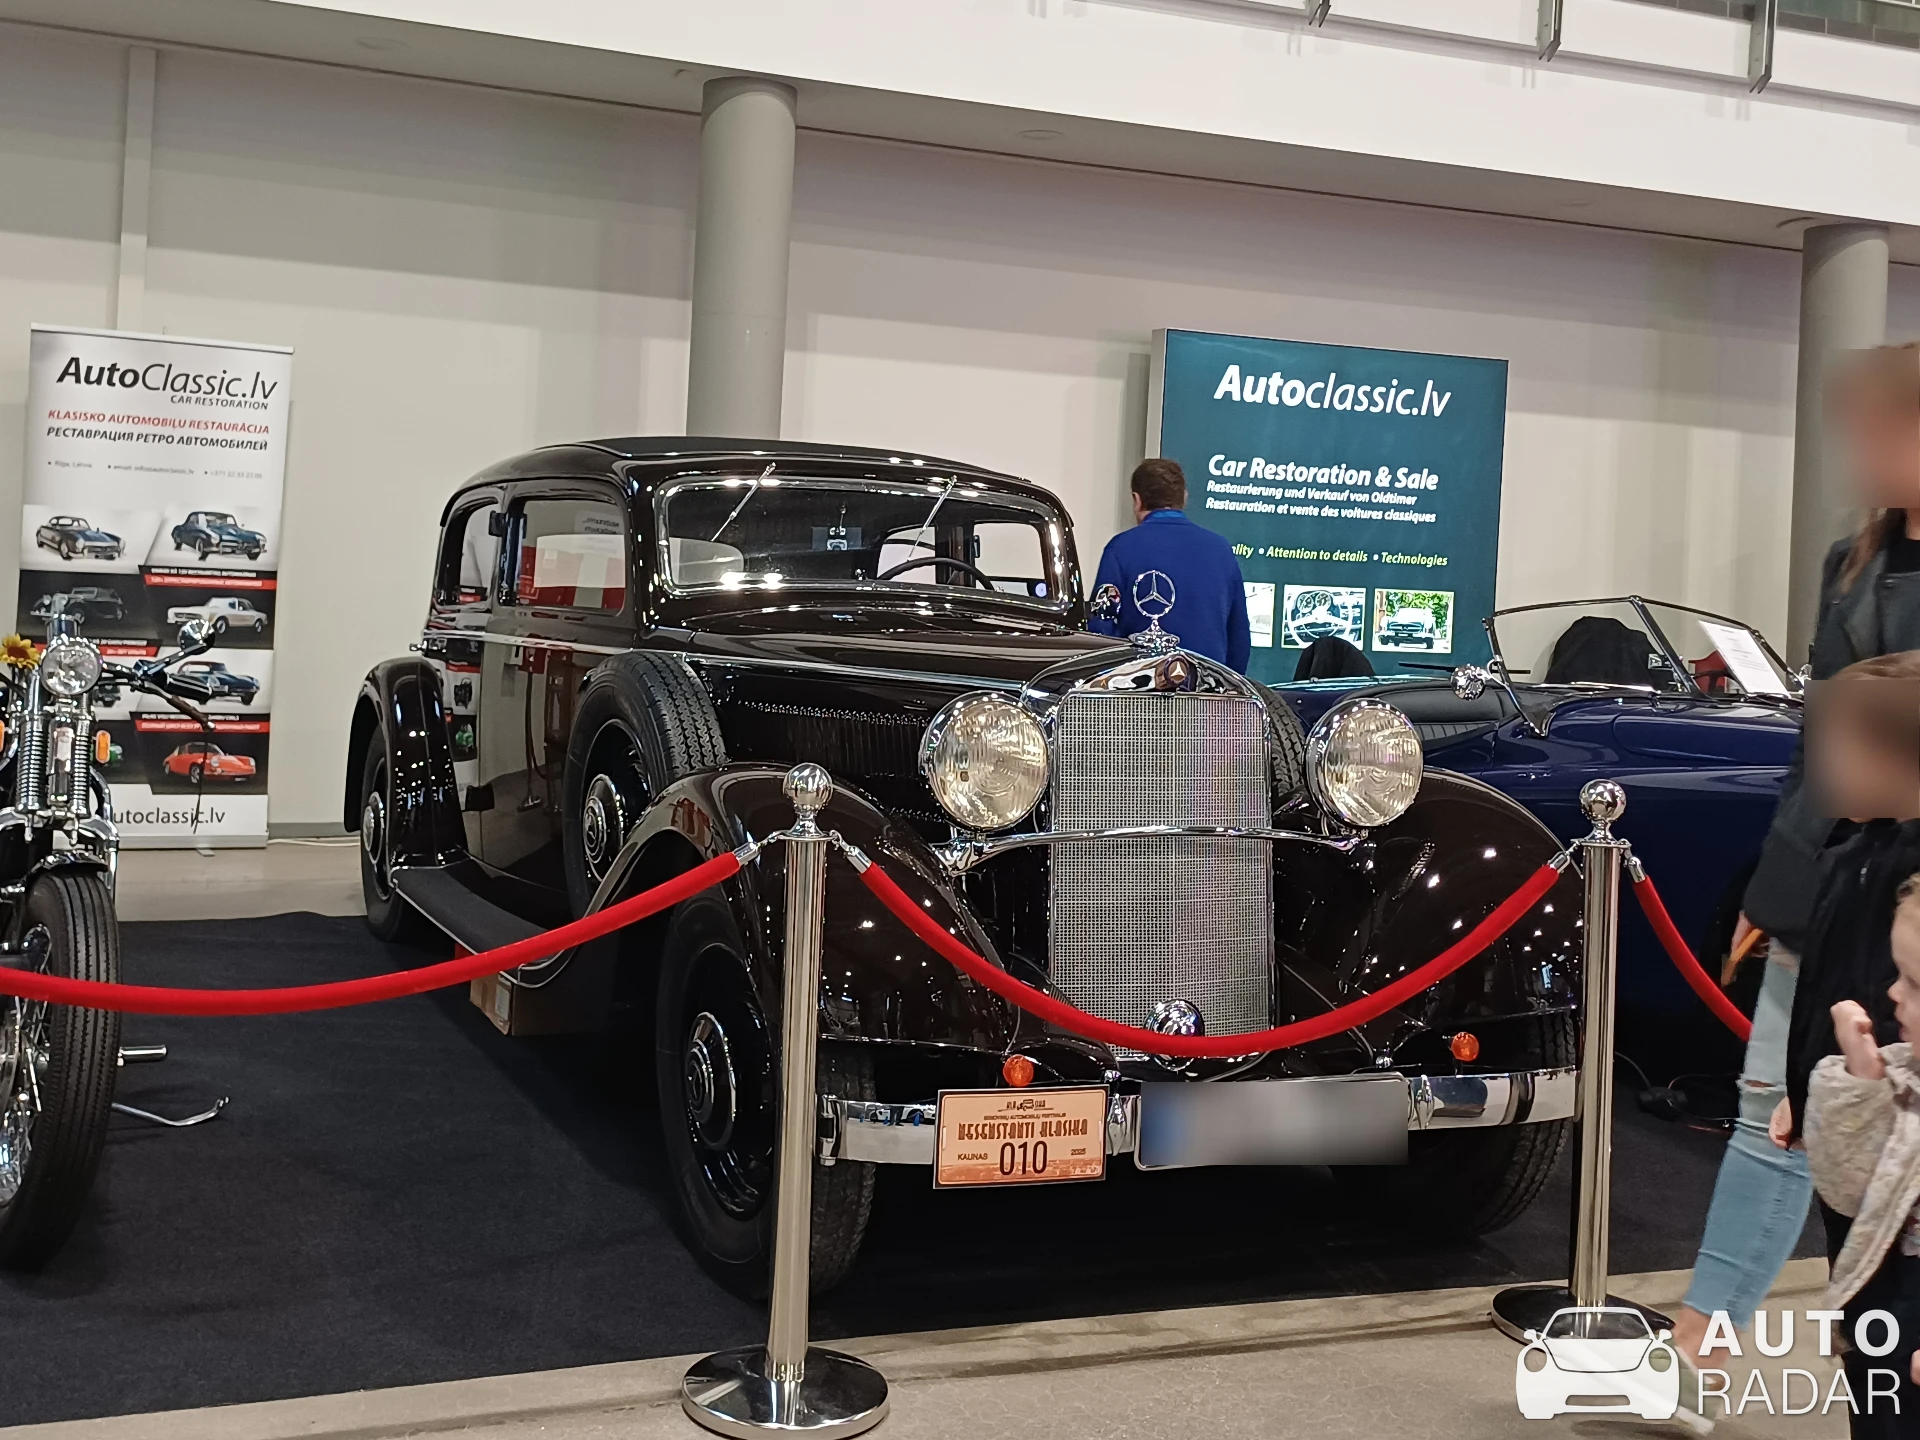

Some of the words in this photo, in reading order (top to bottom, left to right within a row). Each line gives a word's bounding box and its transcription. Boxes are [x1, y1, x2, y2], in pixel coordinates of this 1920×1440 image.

[56, 356, 278, 401] AutoClassic.lv
[1213, 363, 1452, 418] Autoclassic.lv
[170, 394, 192, 404] CAR
[195, 396, 269, 410] RESTORATION
[48, 409, 106, 423] KLASISKO
[46, 426, 134, 442] РЕСТАВРАЦИЯ
[136, 433, 175, 445] РЕТРО
[177, 435, 268, 451] АВТОМОБИЛЕЙ
[1208, 454, 1247, 478] Car
[1249, 457, 1372, 487] Restoration
[1375, 465, 1392, 488] &
[1394, 467, 1439, 491] Sale
[1206, 480, 1284, 500] Restaurierung
[1284, 486, 1307, 499] und
[1307, 486, 1350, 502] Verkauf
[1350, 492, 1370, 503] von
[1371, 491, 1418, 506] Oldtimer
[1205, 496, 1276, 514] Restauration
[1276, 503, 1289, 515] et
[1290, 506, 1320, 517] vente
[1320, 504, 1340, 518] des
[1341, 506, 1383, 520] voitures
[1384, 508, 1437, 525] classiques
[1266, 545, 1318, 561] Attention
[1319, 549, 1331, 561] to
[1332, 549, 1368, 563] details
[1381, 551, 1448, 569] Technologies
[113, 806, 226, 825] utoclassic.lv
[957, 1152, 988, 1161] KAUNAS
[999, 1140, 1048, 1176] 010
